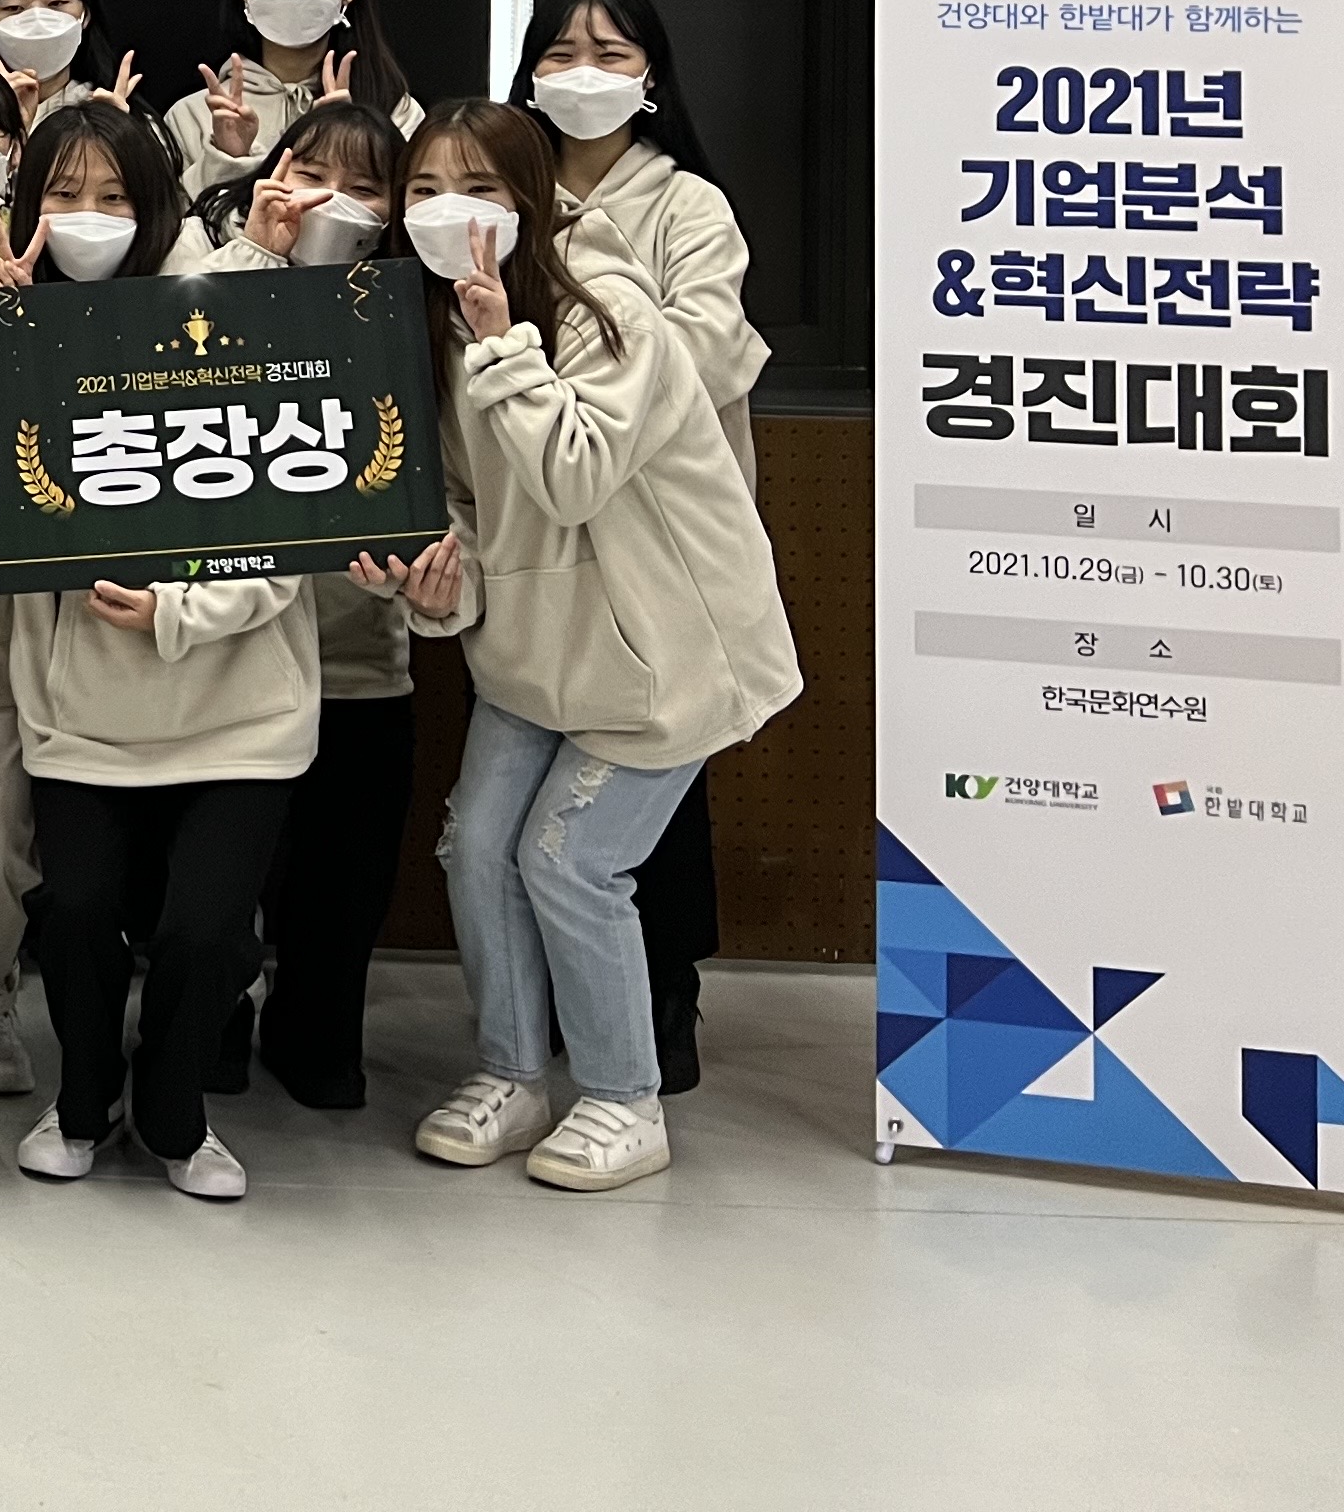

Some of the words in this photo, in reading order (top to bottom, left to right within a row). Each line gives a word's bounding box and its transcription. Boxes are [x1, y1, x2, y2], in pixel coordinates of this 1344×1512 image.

[937, 2, 1050, 32] 건양대와
[1058, 3, 1175, 33] 한밭대가
[1184, 4, 1303, 35] 함께하는
[996, 65, 1244, 139] 2021년
[961, 158, 1283, 236] 기업분석
[932, 249, 1320, 332] &혁신전략
[76, 375, 116, 394] 2021
[121, 363, 262, 391] 기업분석&혁신전략
[265, 359, 331, 383] 경진대회
[922, 353, 1329, 458] 경진대회
[71, 398, 354, 507] 총장상
[206, 555, 276, 575] 건양대학교
[969, 550, 1144, 585] 2021.10.29(금)
[1177, 563, 1283, 594] 10.30(토)
[1041, 685, 1208, 723] 한국문화연수원
[945, 772, 999, 800] KY
[1005, 776, 1099, 800] 건양대학교
[1205, 796, 1308, 824] 한밭대학교
